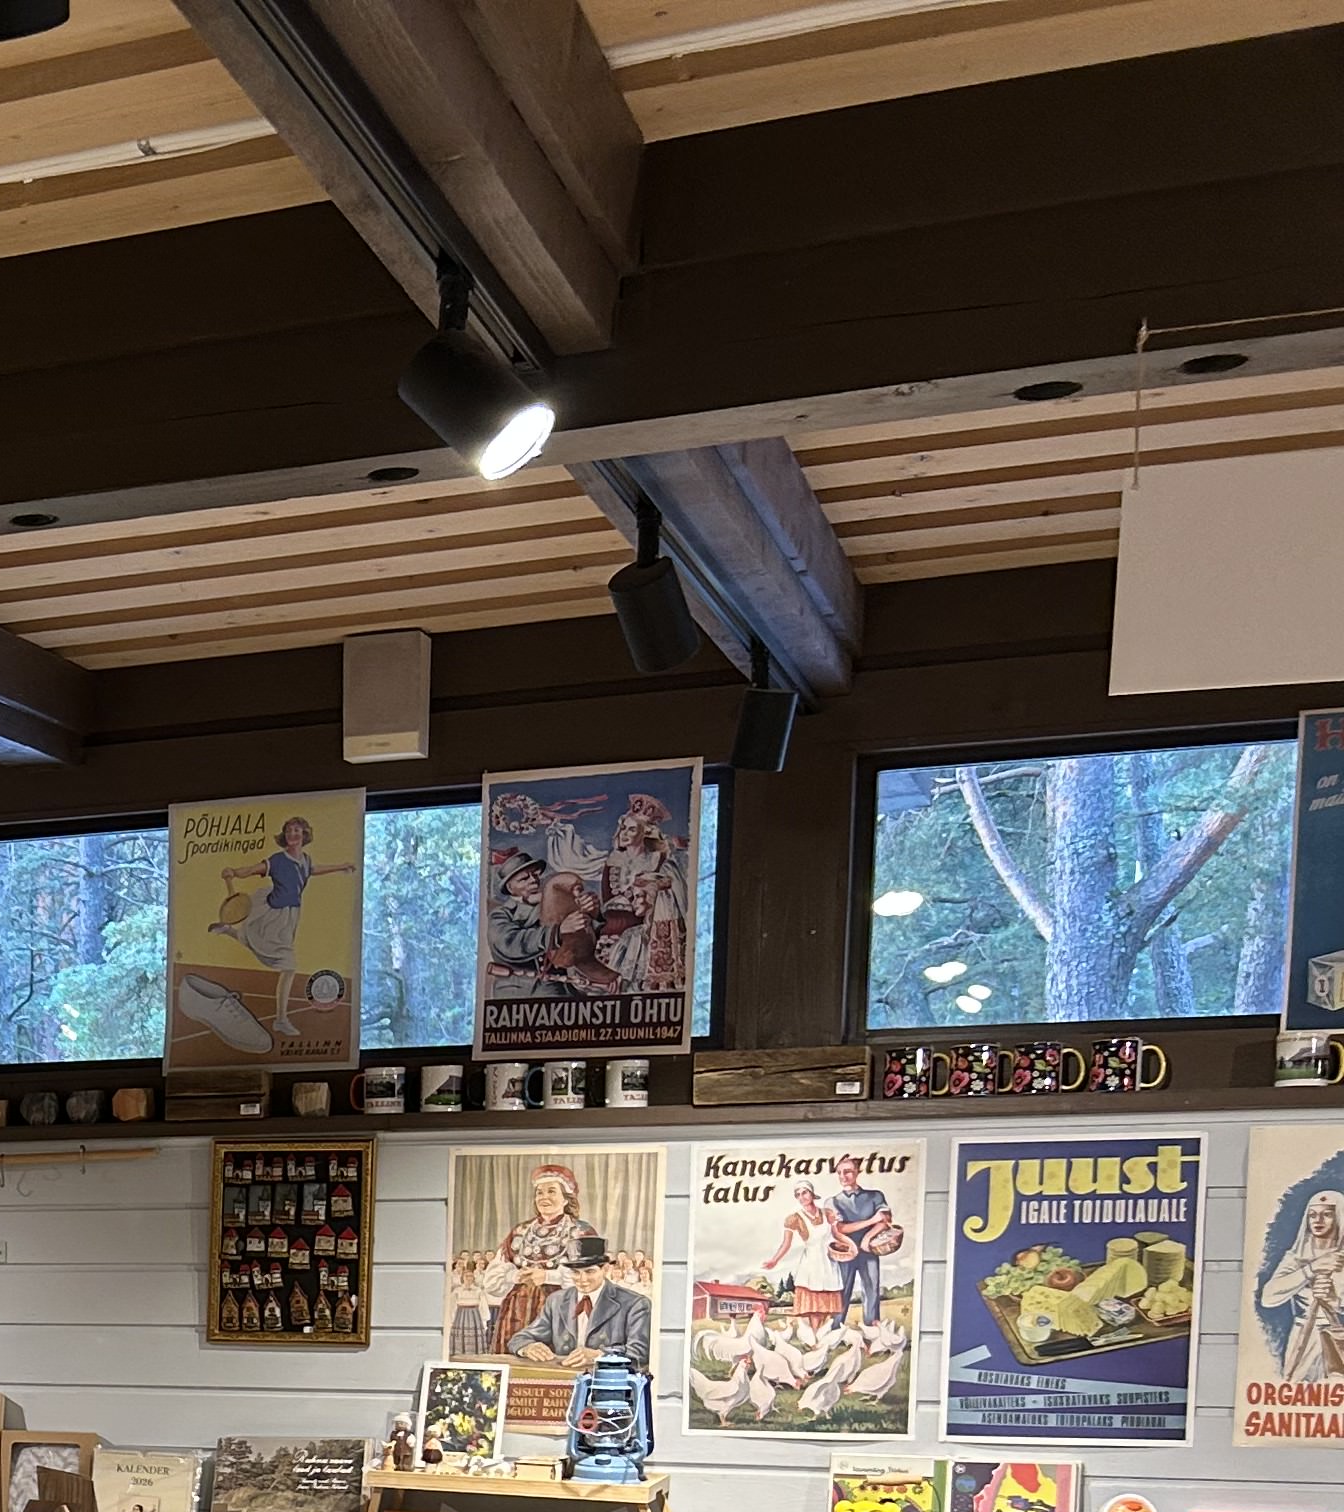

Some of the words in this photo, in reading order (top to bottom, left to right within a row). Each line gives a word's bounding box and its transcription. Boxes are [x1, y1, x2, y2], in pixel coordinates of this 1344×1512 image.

[183, 812, 266, 839] PÕHJALA
[177, 836, 266, 865] Spordikingad
[484, 1000, 621, 1029] RAHVAKUNSTI
[629, 996, 683, 1024] ÕHTU
[483, 1031, 533, 1045] TALLINNA
[534, 1028, 598, 1043] STAADIONIL
[614, 1027, 654, 1041] JUUNIL
[654, 1025, 682, 1039] 1947
[701, 1179, 776, 1204] talus
[962, 1145, 1198, 1244] Juust
[1020, 1200, 1068, 1225] IGALE
[1072, 1198, 1188, 1224] TOIDULAUALE
[1246, 1382, 1344, 1407] ORGANIS
[1243, 1410, 1344, 1439] SANITAA
[115, 1463, 171, 1477] KALENDER
[130, 1476, 154, 1487] 2026
